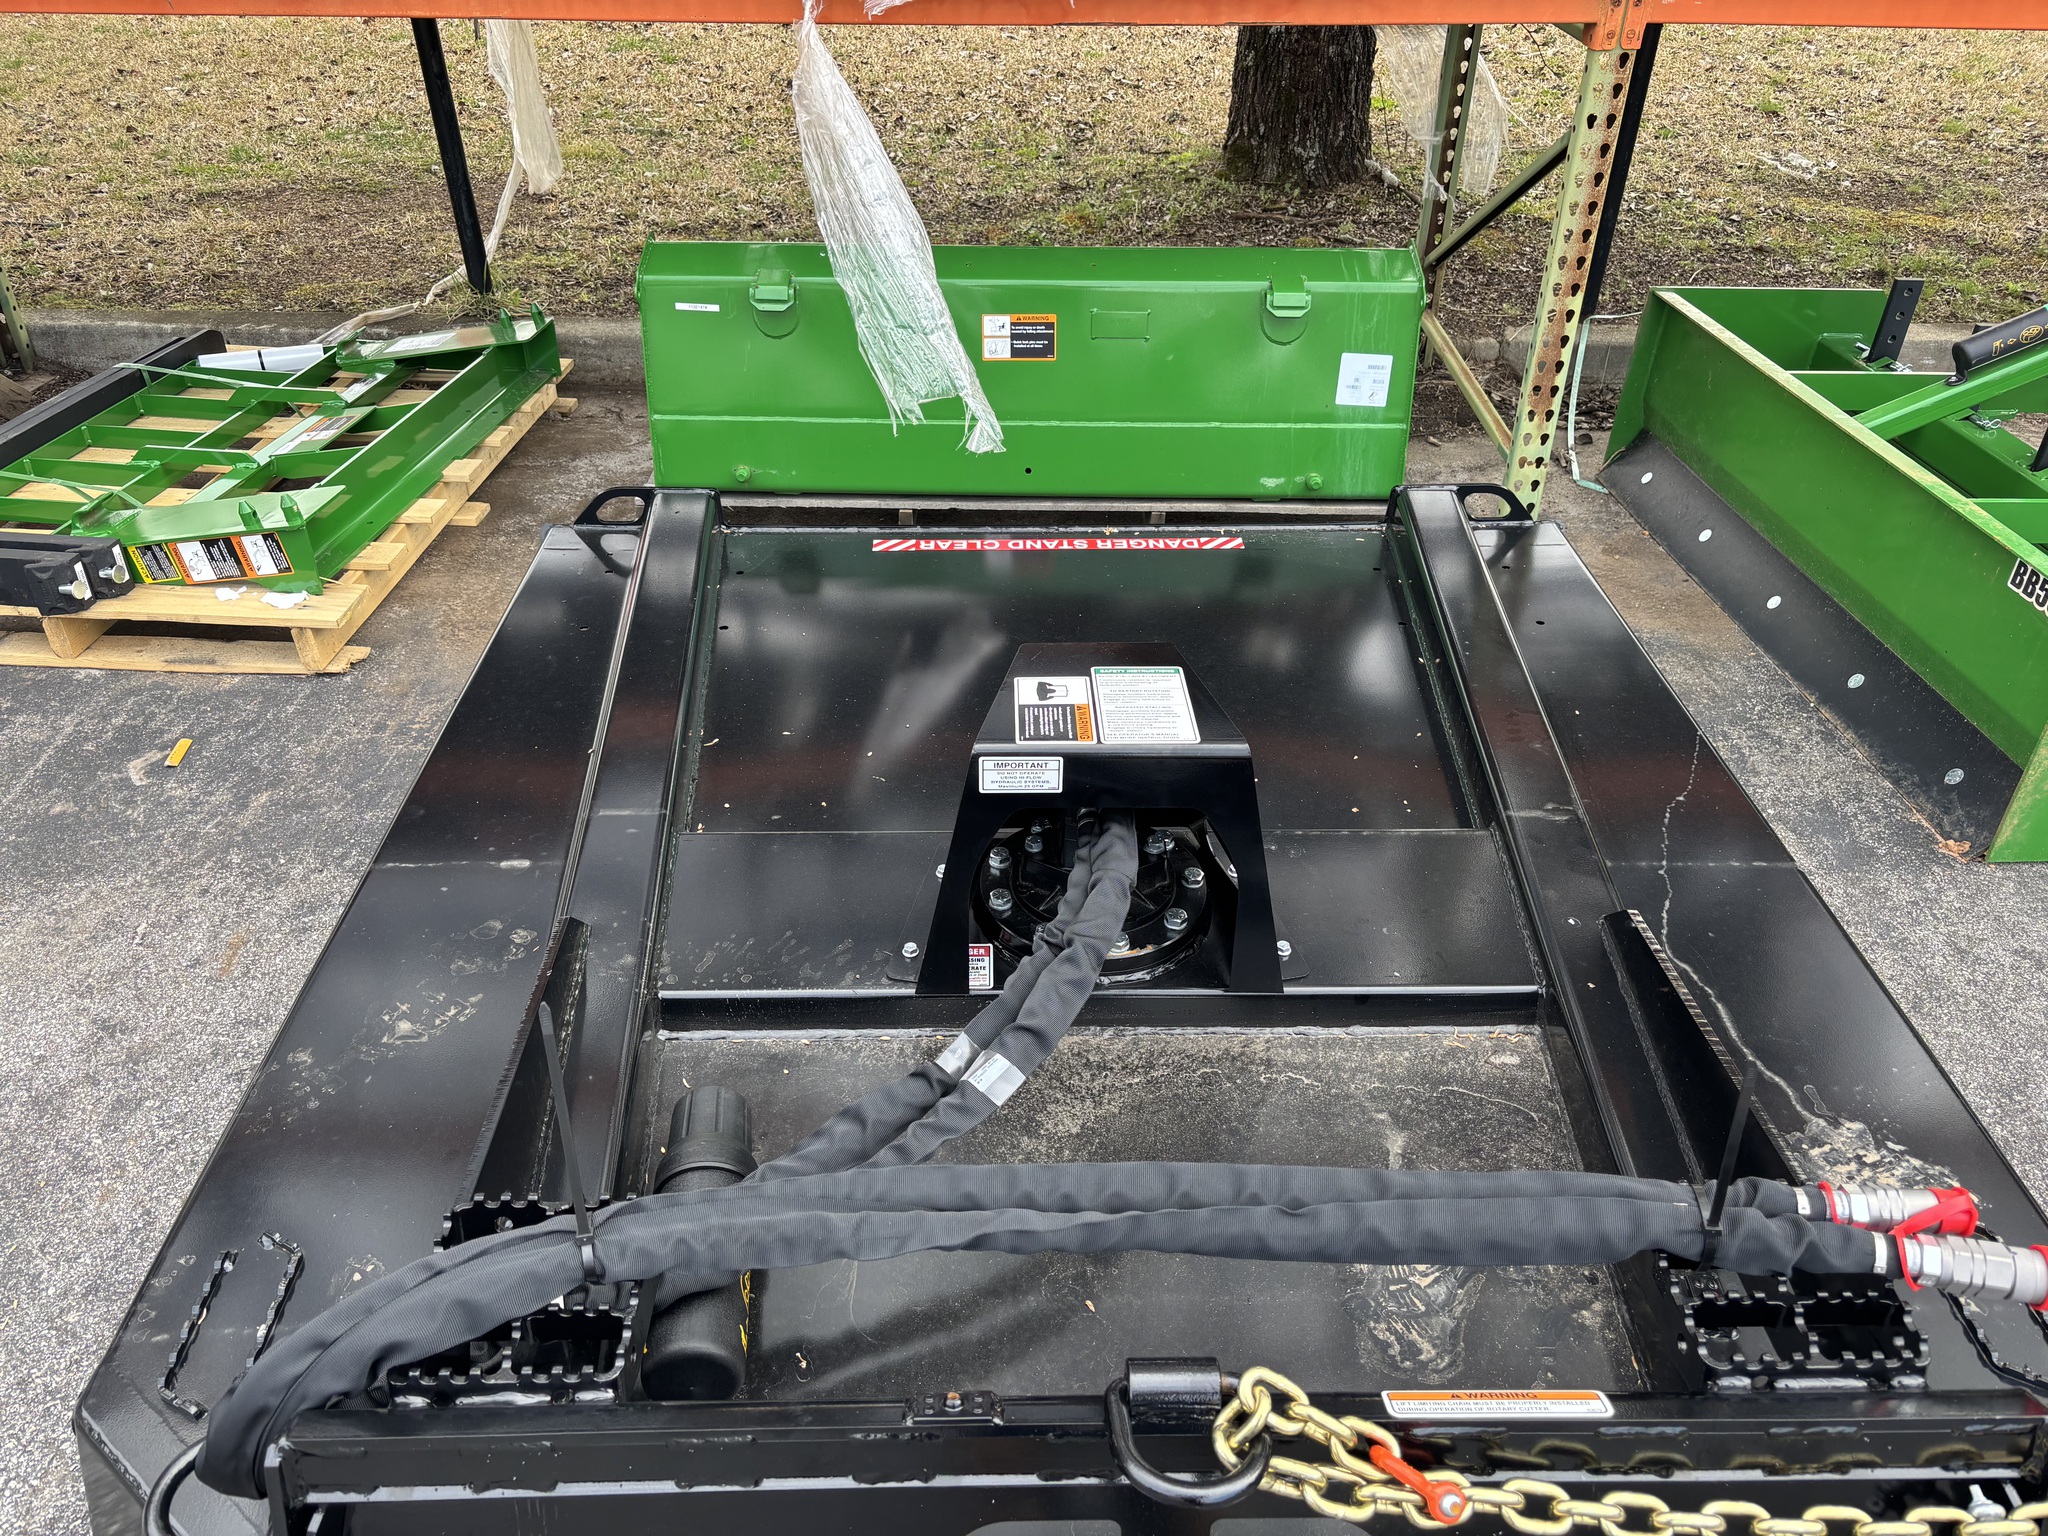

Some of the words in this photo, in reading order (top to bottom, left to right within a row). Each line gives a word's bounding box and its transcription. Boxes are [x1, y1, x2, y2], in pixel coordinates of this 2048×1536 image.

[236, 541, 252, 568] WARNING
[919, 539, 1001, 550] CLEAR
[1007, 539, 1089, 550] STAND
[1096, 538, 1200, 549] DANGER
[131, 550, 148, 575] CAUTION
[172, 547, 188, 575] WARNING
[2009, 559, 2048, 613] BB5
[1077, 711, 1090, 740] WARNING
